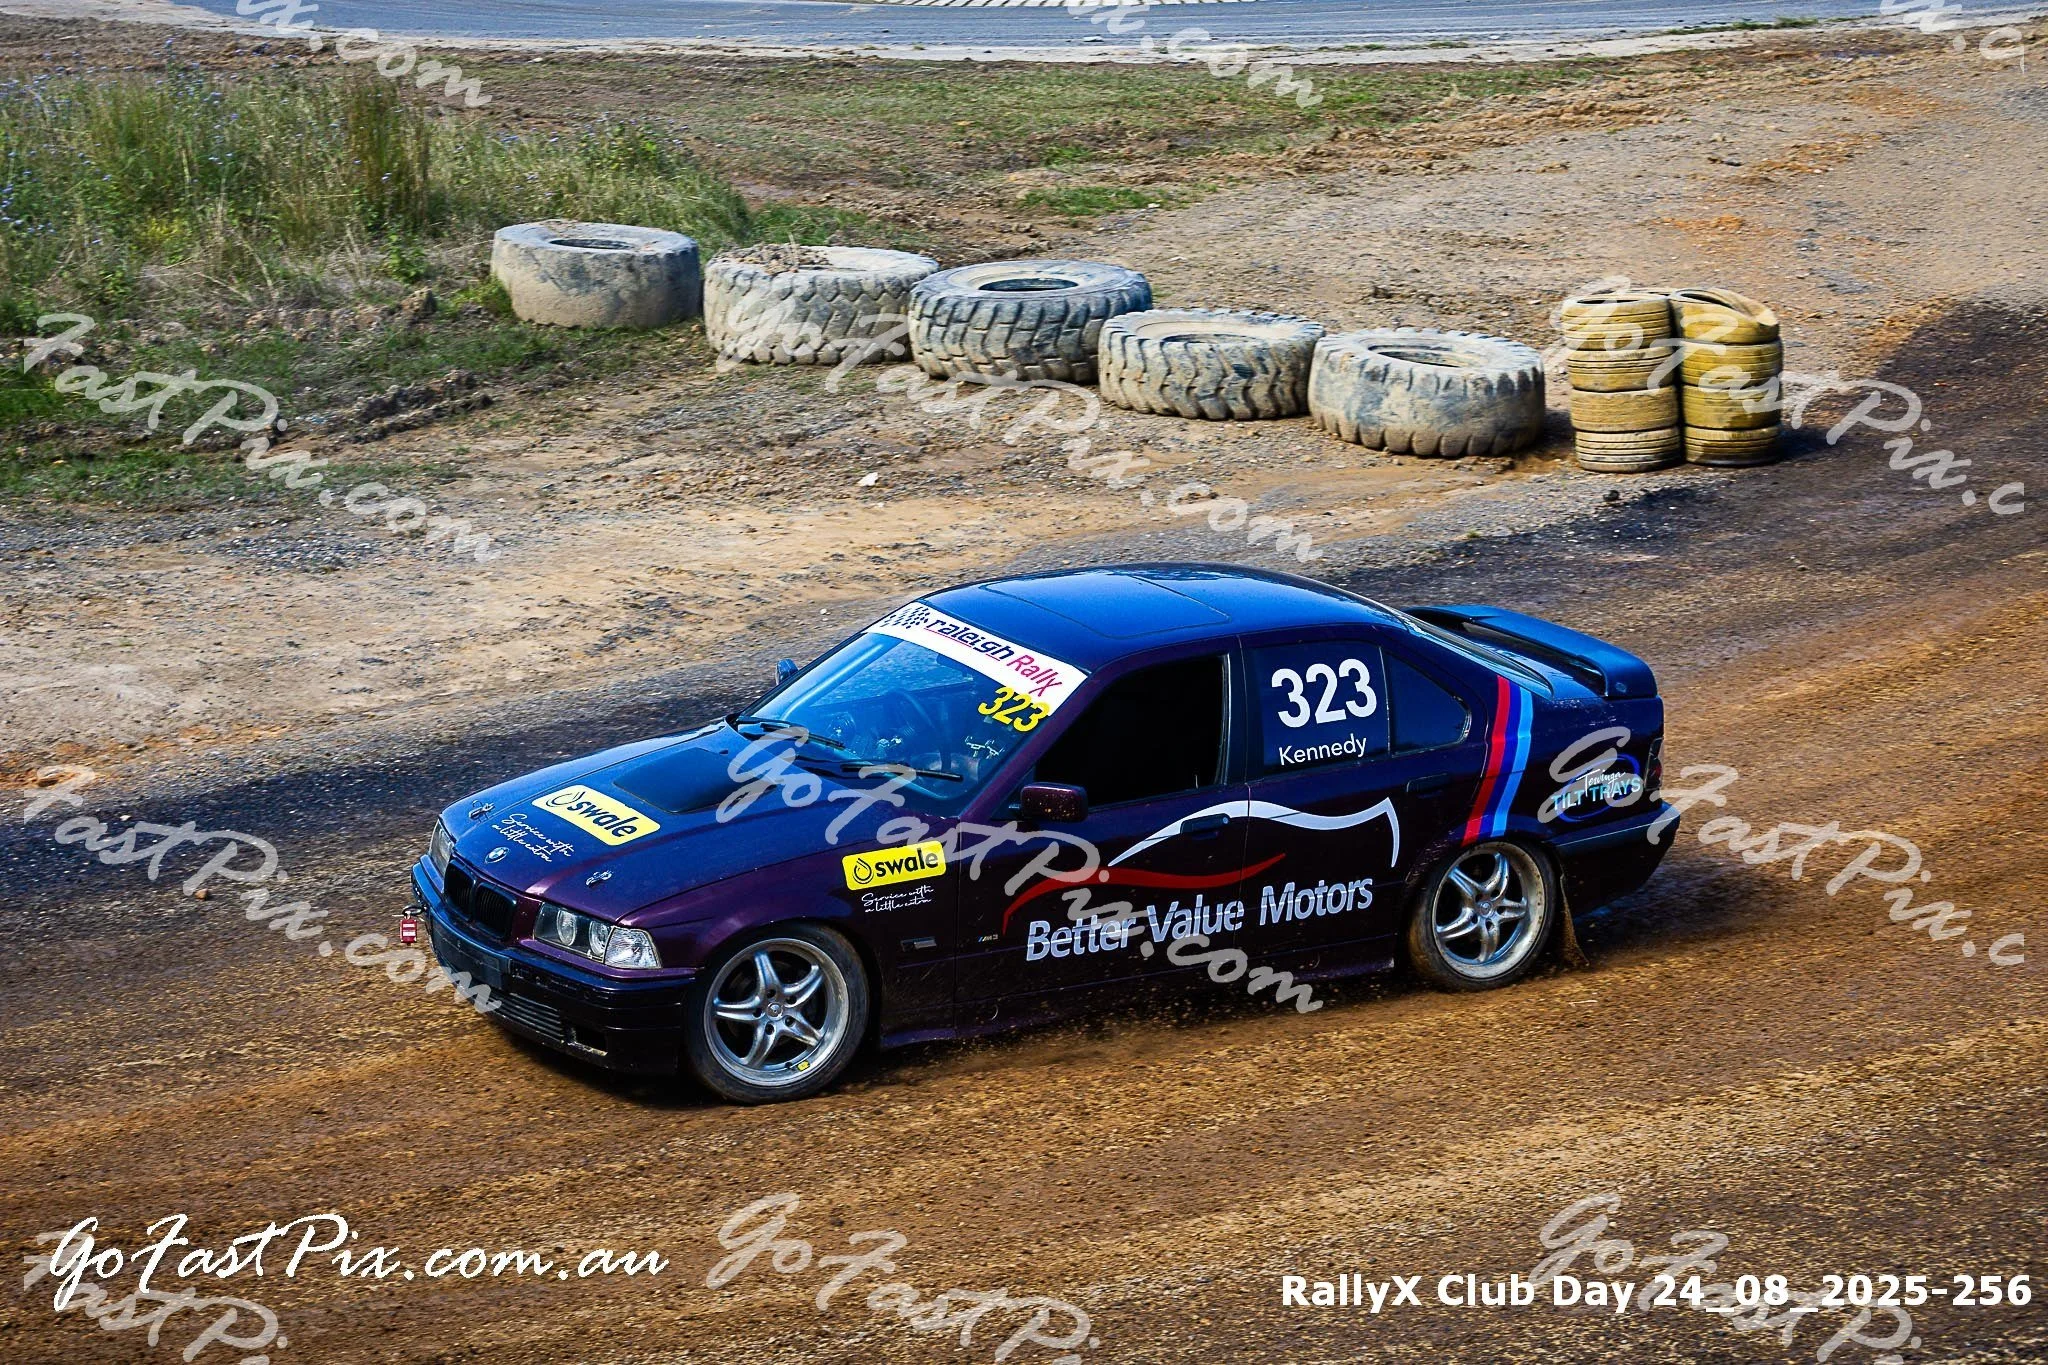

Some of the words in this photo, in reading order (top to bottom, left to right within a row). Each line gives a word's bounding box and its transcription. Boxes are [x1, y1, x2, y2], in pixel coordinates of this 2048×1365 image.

[926, 617, 1015, 661] raleigh
[977, 686, 1051, 732] 323
[1271, 658, 1378, 728] 323
[1278, 732, 1367, 766] Kennedy
[1551, 788, 1585, 812] TILT
[1588, 776, 1641, 802] TRAYS
[566, 801, 638, 838] swale
[874, 847, 939, 878] swale
[1026, 914, 1136, 962] Better
[1146, 894, 1244, 944] Value
[1260, 878, 1373, 926] Motors
